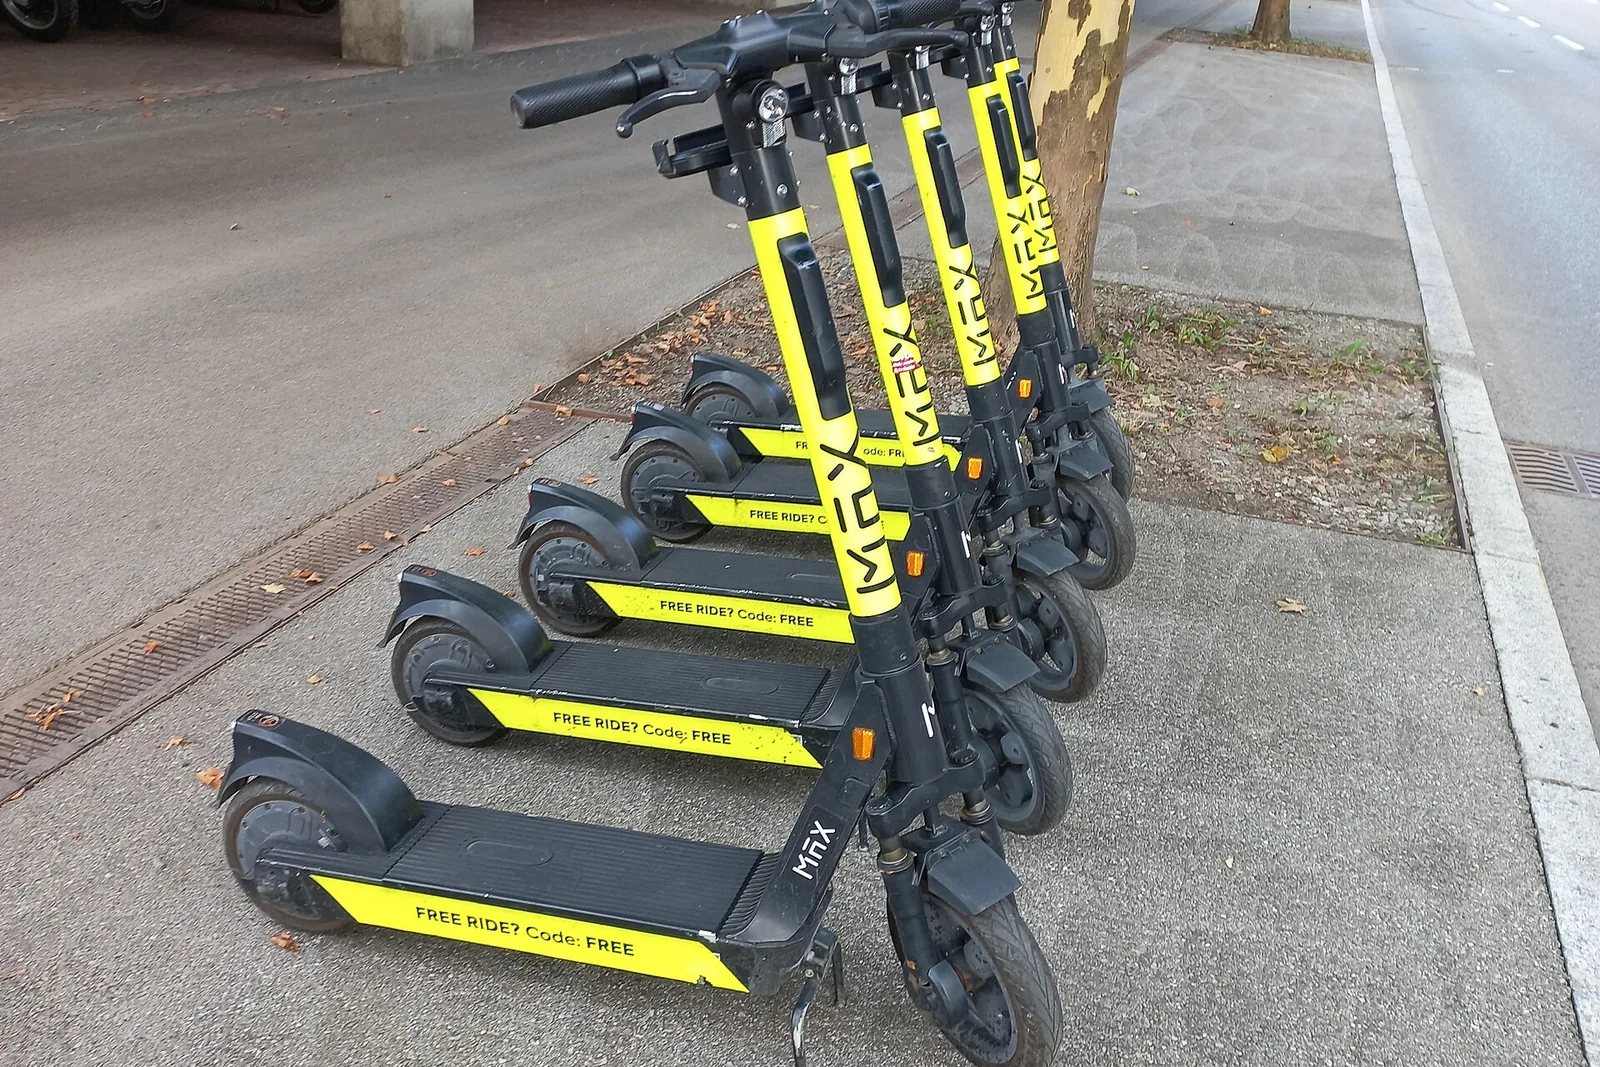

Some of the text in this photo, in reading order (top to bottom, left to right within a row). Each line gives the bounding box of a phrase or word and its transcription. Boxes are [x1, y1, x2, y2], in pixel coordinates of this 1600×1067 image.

[795, 441, 905, 459] FR ode: FR
[749, 509, 779, 520] FREE
[781, 512, 815, 523] RIDE?
[660, 600, 814, 627] FREE RIDE? Code: FREE
[553, 712, 732, 745] FREE RIDE? Code: FREE
[415, 906, 635, 957] FREE RIDE? Code: FREE
